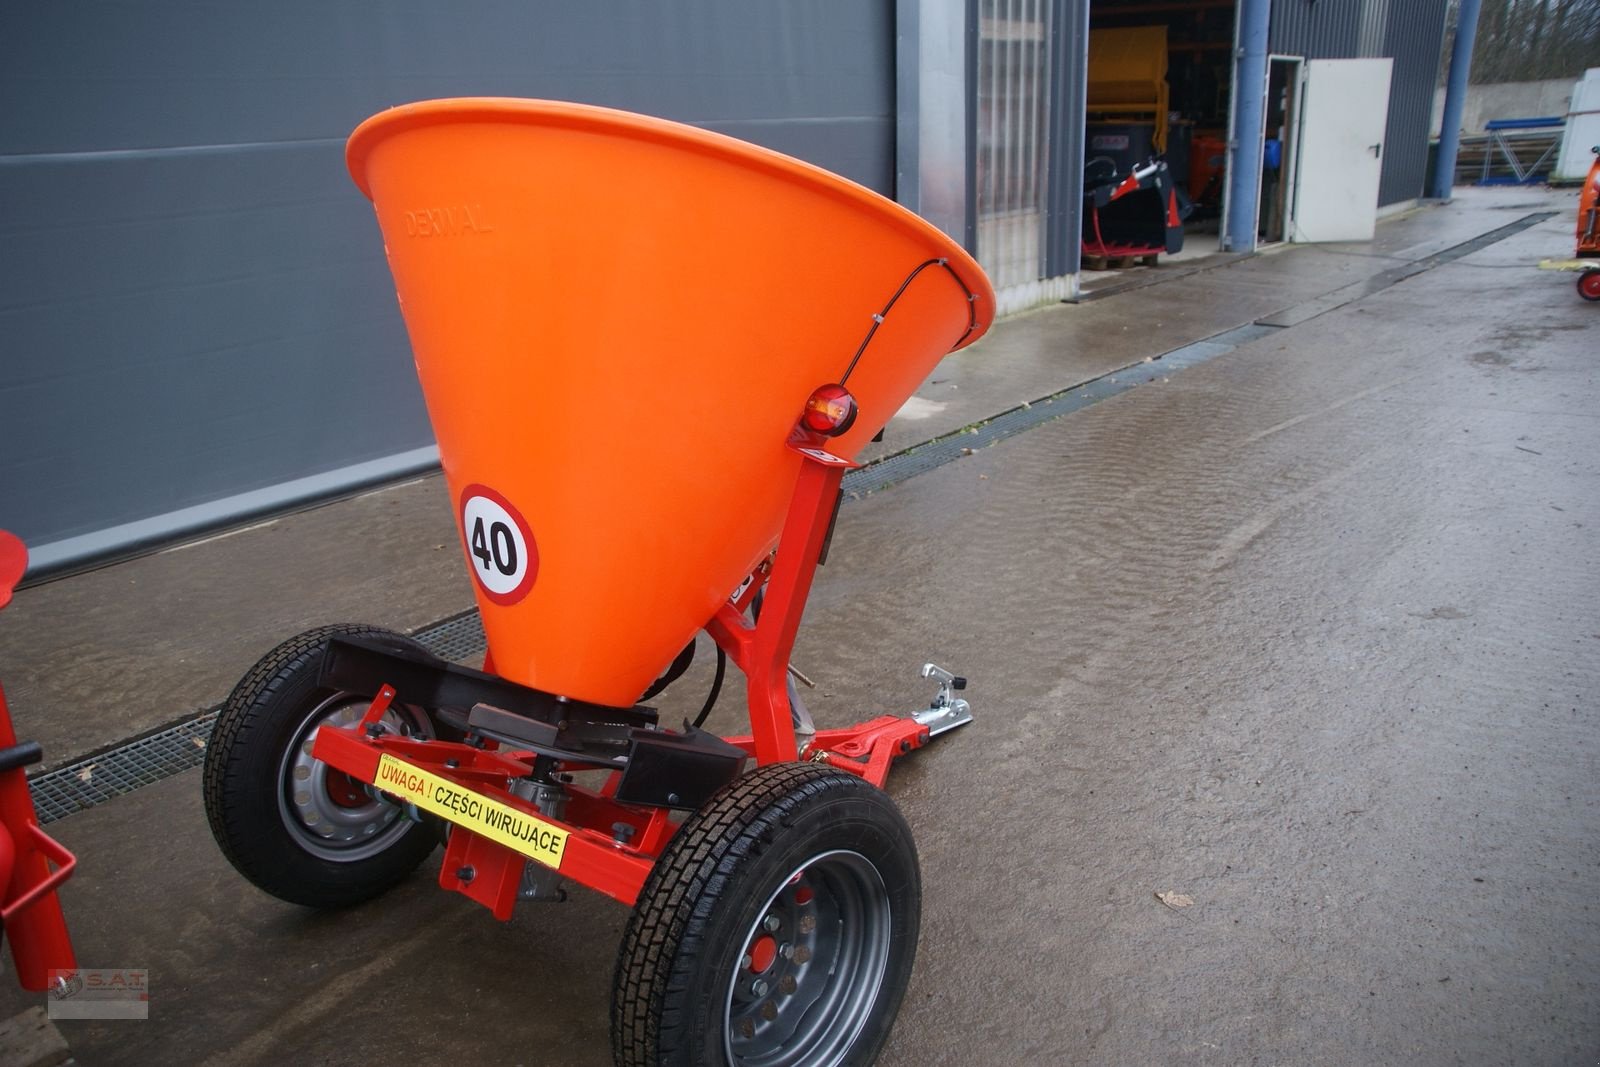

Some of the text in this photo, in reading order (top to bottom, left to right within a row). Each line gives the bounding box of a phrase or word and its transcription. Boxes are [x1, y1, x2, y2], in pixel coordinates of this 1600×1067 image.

[472, 516, 517, 576] 40
[381, 763, 425, 796] UWAGA
[435, 786, 482, 820] CZĘŚCI
[485, 806, 561, 854] WIRUJĄCE
